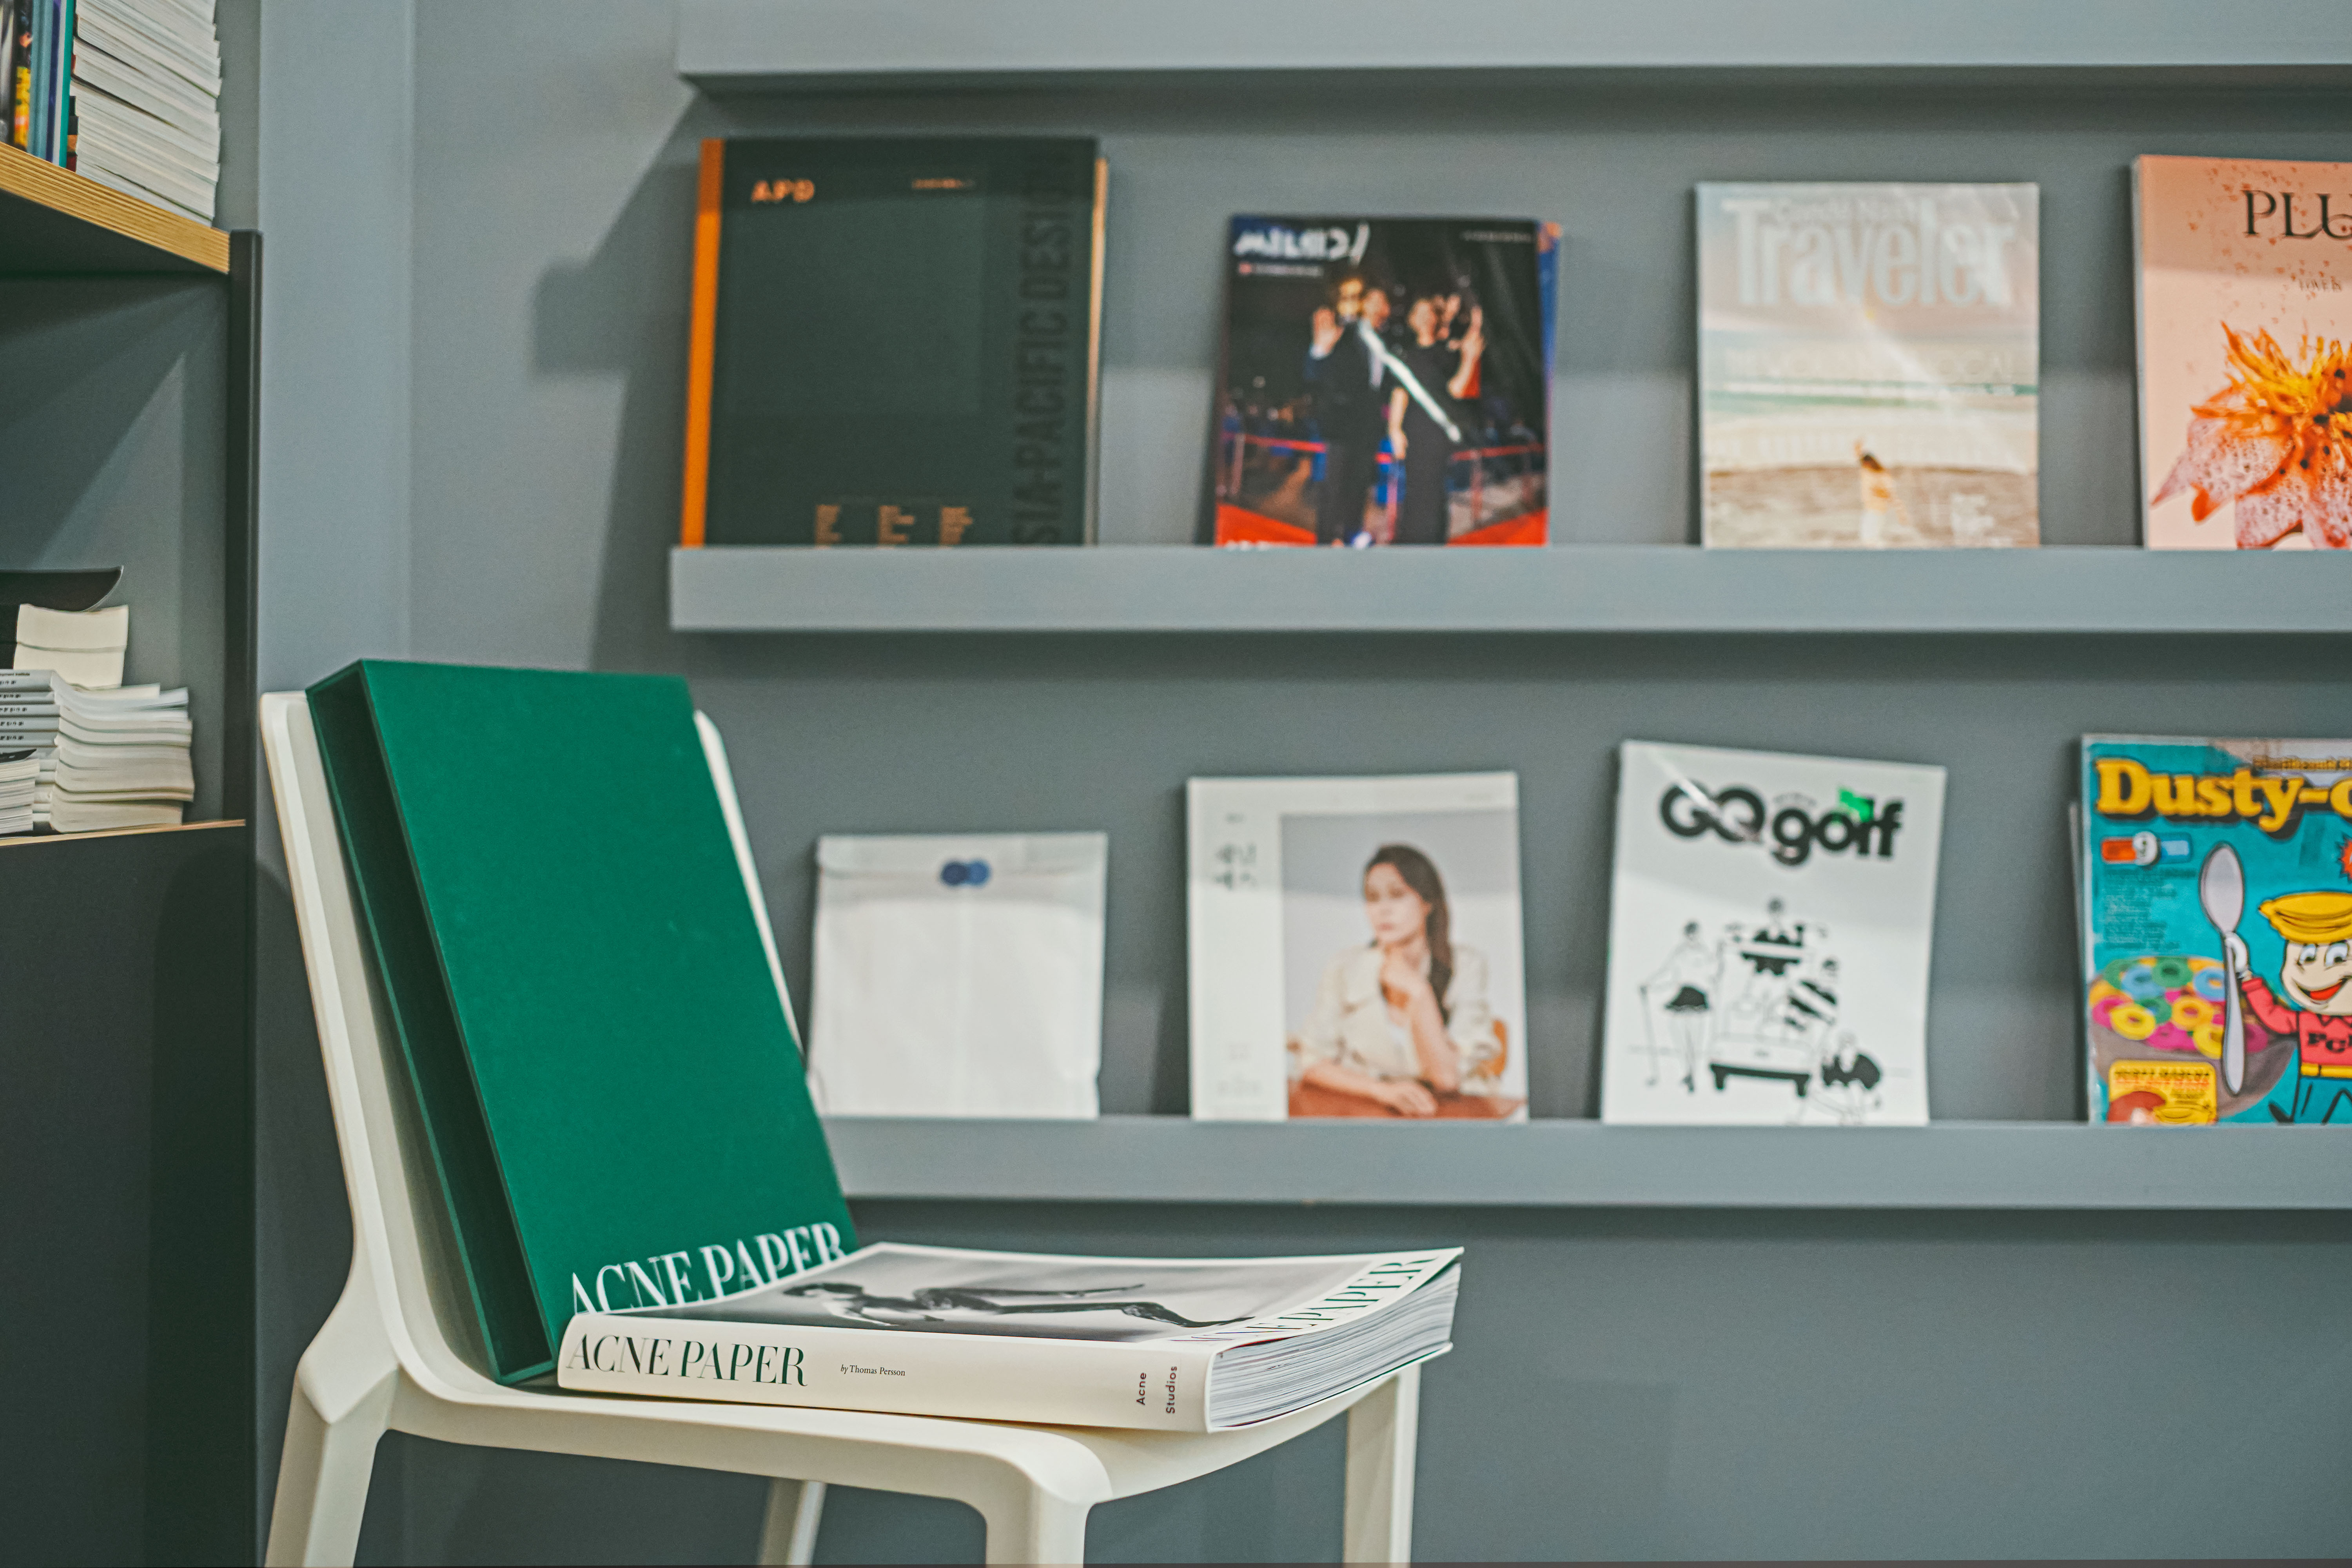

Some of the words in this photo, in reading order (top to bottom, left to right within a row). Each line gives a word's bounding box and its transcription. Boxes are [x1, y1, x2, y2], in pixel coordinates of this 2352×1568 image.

[751, 180, 815, 203] APD
[1721, 199, 2016, 307] Traveler
[1660, 779, 1764, 844] GQ
[1772, 798, 1903, 866] golf
[572, 1250, 702, 1314] ACNE
[699, 1222, 849, 1298] PAPER
[1277, 1258, 1438, 1321] PAPER
[566, 1334, 671, 1376] ACNE
[677, 1341, 808, 1386] PAPER
[841, 1364, 848, 1374] by
[850, 1365, 877, 1374] Thomas
[880, 1367, 906, 1376] Persson
[1136, 1373, 1146, 1405] Acne
[1166, 1366, 1177, 1414] Studios
